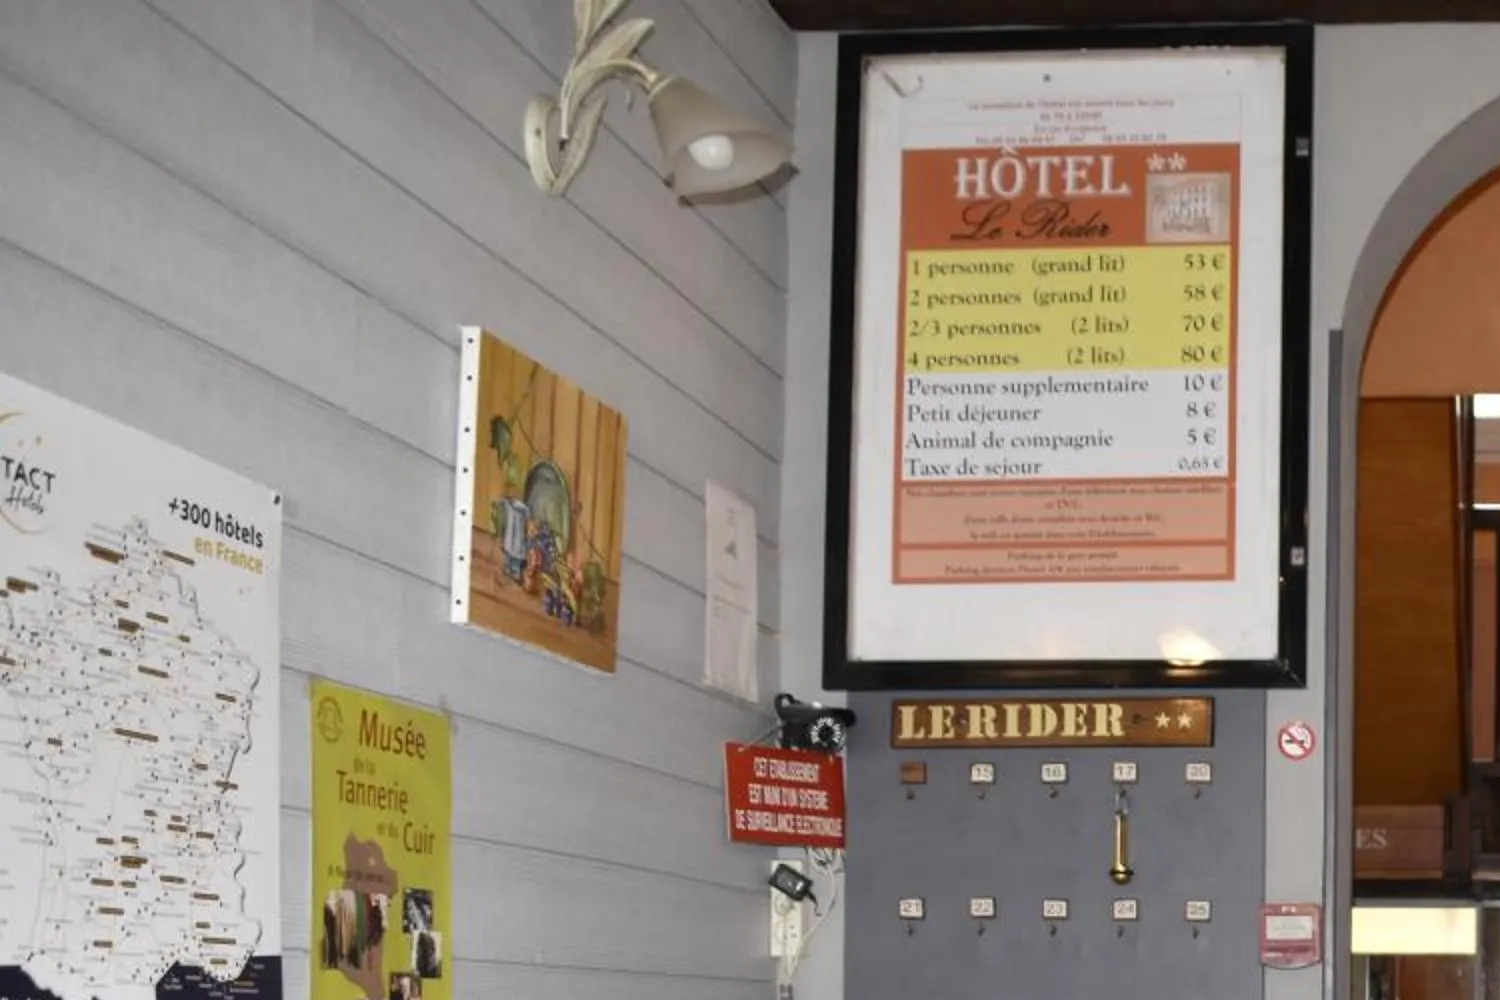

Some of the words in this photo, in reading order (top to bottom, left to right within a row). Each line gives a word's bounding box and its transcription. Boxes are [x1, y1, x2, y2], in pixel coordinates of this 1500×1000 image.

[953, 145, 1132, 200] HÔTEL
[949, 200, 1011, 241] Le
[1015, 199, 1112, 240] Rider
[912, 260, 920, 275] 1
[928, 261, 1014, 279] personne
[1031, 257, 1092, 278] (grand
[1099, 255, 1125, 274] lit)
[1184, 254, 1206, 270] 53
[1211, 254, 1225, 270] €
[910, 290, 920, 306] 2
[926, 290, 1022, 309] personnes
[1033, 288, 1094, 308] (grand
[1100, 285, 1126, 304] lit)
[1183, 285, 1206, 300] 58
[1211, 284, 1225, 300] €
[909, 320, 941, 337] 2/3
[947, 321, 1042, 340] personnes
[1071, 317, 1089, 336] (2
[1094, 315, 1130, 334] lits)
[1182, 315, 1205, 333] 70
[1210, 315, 1224, 332] €
[907, 352, 918, 367] 4
[925, 351, 1020, 370] personnes
[1066, 348, 1085, 367] (2
[1089, 346, 1125, 365] lits)
[1180, 346, 1205, 362] 80
[1210, 346, 1225, 362] €
[907, 377, 997, 396] Personne
[1183, 375, 1204, 391] 10
[1210, 374, 1224, 391] €
[907, 404, 951, 422] Petit
[957, 404, 1042, 425] déjeuner
[1186, 401, 1198, 418] 8
[1203, 401, 1217, 418] €
[905, 431, 976, 449] Animal
[982, 430, 1004, 447] de
[1010, 429, 1114, 450] compagnie
[1186, 428, 1198, 445] 5
[1203, 428, 1217, 446] €
[906, 457, 951, 476] Taxe
[956, 457, 978, 475] de
[168, 498, 211, 529] +300
[215, 511, 264, 548] hôtels
[194, 537, 213, 558] en
[216, 541, 264, 575] France
[358, 708, 428, 761] Musée
[898, 704, 956, 740] LE
[965, 702, 1125, 739] RIDER
[335, 769, 409, 815] Tannerie
[403, 821, 436, 855] Cuir
